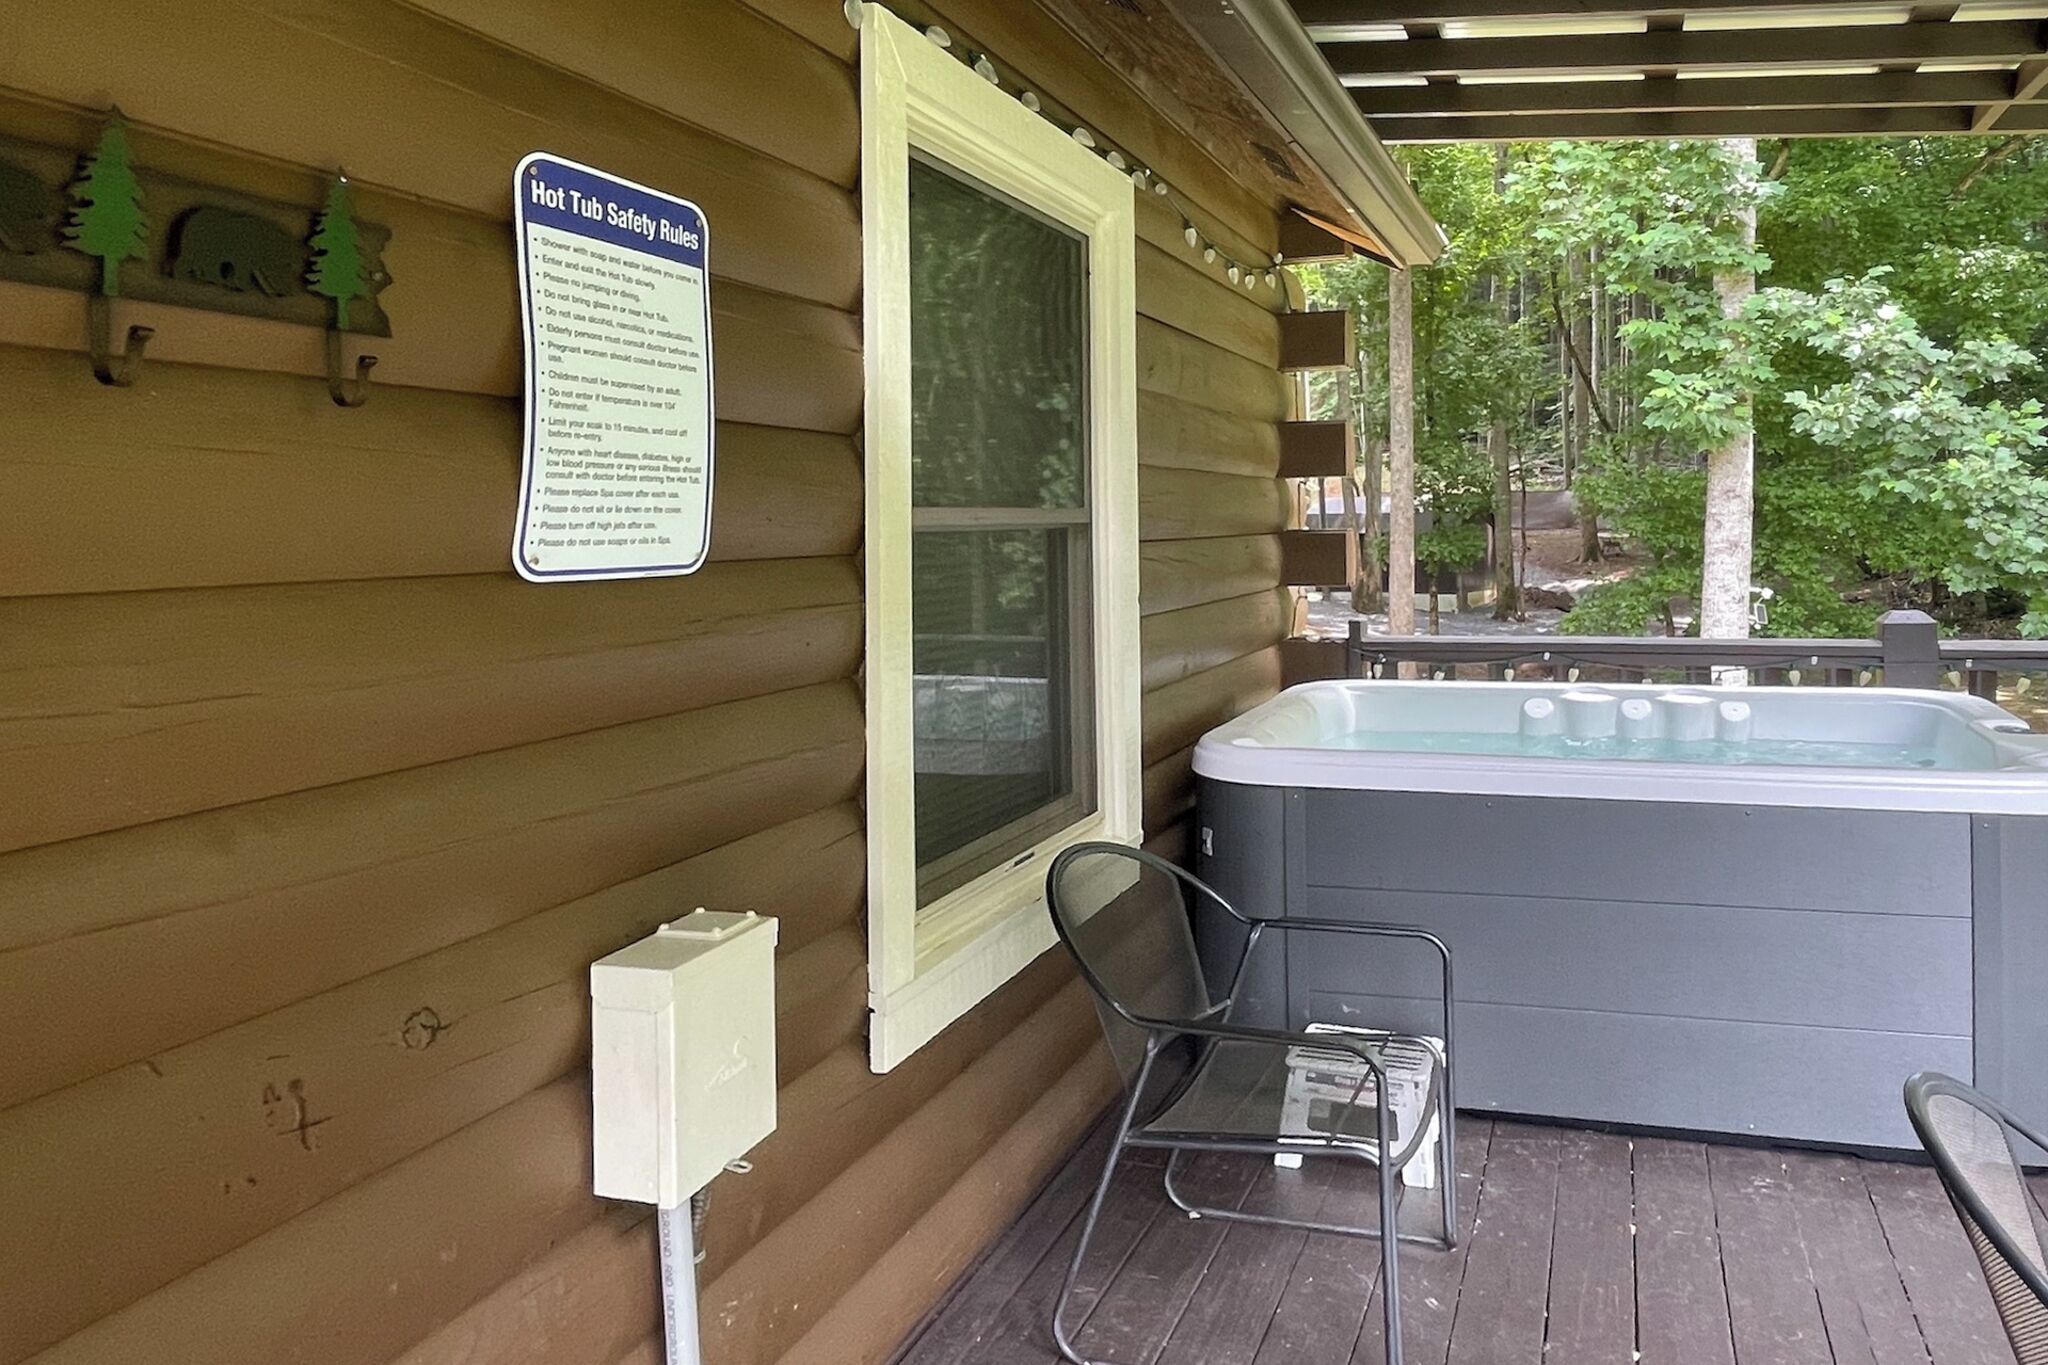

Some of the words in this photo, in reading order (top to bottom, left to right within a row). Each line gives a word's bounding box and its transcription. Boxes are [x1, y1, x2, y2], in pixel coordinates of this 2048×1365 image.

[531, 179, 566, 211] Hot
[569, 190, 603, 221] Tub
[607, 202, 656, 241] Safety
[660, 218, 699, 250] Rules
[541, 237, 570, 251] Shower
[573, 246, 588, 256] with
[590, 250, 607, 262] soap
[609, 255, 621, 265] and
[642, 264, 662, 275] before
[542, 254, 562, 266] Enter
[565, 261, 579, 271] and
[581, 265, 594, 273] exit
[596, 268, 606, 277] the
[608, 271, 620, 280] Hot
[622, 273, 634, 284] Tub
[543, 271, 569, 285] Please
[571, 279, 580, 287] no
[582, 282, 610, 296] jumping
[612, 288, 619, 296] or
[544, 288, 556, 299] Do
[572, 295, 591, 308] bring
[592, 300, 610, 310] glass
[628, 308, 641, 317] near
[643, 311, 655, 319] Hot
[545, 306, 557, 316] Do
[559, 310, 571, 318] not
[573, 313, 586, 322] use
[547, 323, 572, 337] Elderly
[574, 330, 603, 341] persons
[604, 336, 621, 344] must
[622, 339, 646, 349] consult
[646, 342, 666, 352] doctor
[668, 346, 687, 356] before
[548, 340, 581, 353] Pregnant
[583, 349, 608, 358] women
[610, 352, 632, 363] should
[632, 356, 656, 366] consult
[657, 360, 677, 369] doctor
[678, 363, 697, 373] before
[548, 369, 579, 382] Children
[581, 376, 598, 384] must
[600, 377, 609, 386] be
[611, 380, 646, 391] supervised
[647, 384, 655, 393] by
[548, 387, 560, 397] Do
[561, 390, 573, 399] not
[575, 392, 594, 401] enter
[601, 394, 641, 406] temperature
[649, 401, 663, 409] over
[548, 429, 572, 438] before
[549, 416, 567, 425] Limit
[568, 420, 585, 429] your
[587, 421, 602, 430] soak
[604, 422, 612, 431] to
[614, 423, 621, 431] 15
[651, 428, 664, 436] and
[665, 429, 678, 437] cool
[679, 429, 688, 438] off
[547, 446, 576, 458] Anyone
[577, 448, 592, 457] with
[594, 449, 611, 458] heart
[671, 455, 684, 464] high
[562, 460, 583, 468] blood
[625, 463, 636, 472] any
[638, 464, 661, 472] serious
[662, 464, 681, 473] illness
[682, 465, 702, 473] should
[545, 471, 574, 479] consult
[576, 471, 590, 479] with
[592, 472, 615, 480] doctor
[616, 473, 637, 481] before
[639, 475, 664, 485] entering
[544, 486, 570, 496] Please
[572, 488, 599, 498] replace
[600, 488, 614, 498] Spa
[635, 489, 650, 498] after
[651, 490, 666, 498] each
[542, 503, 568, 513] Please
[570, 504, 580, 513] do
[582, 504, 594, 513] not
[596, 504, 605, 513] sit
[615, 504, 623, 513] lie
[624, 505, 642, 513] down
[653, 505, 663, 513] the
[540, 521, 567, 530] Please
[585, 521, 595, 529] off
[597, 521, 612, 531] high
[613, 521, 626, 530] jets
[627, 521, 642, 529] after
[537, 538, 565, 547] Please
[566, 538, 577, 546] do
[579, 538, 591, 546] not
[608, 538, 628, 546] soaps
[638, 537, 649, 545] oils
